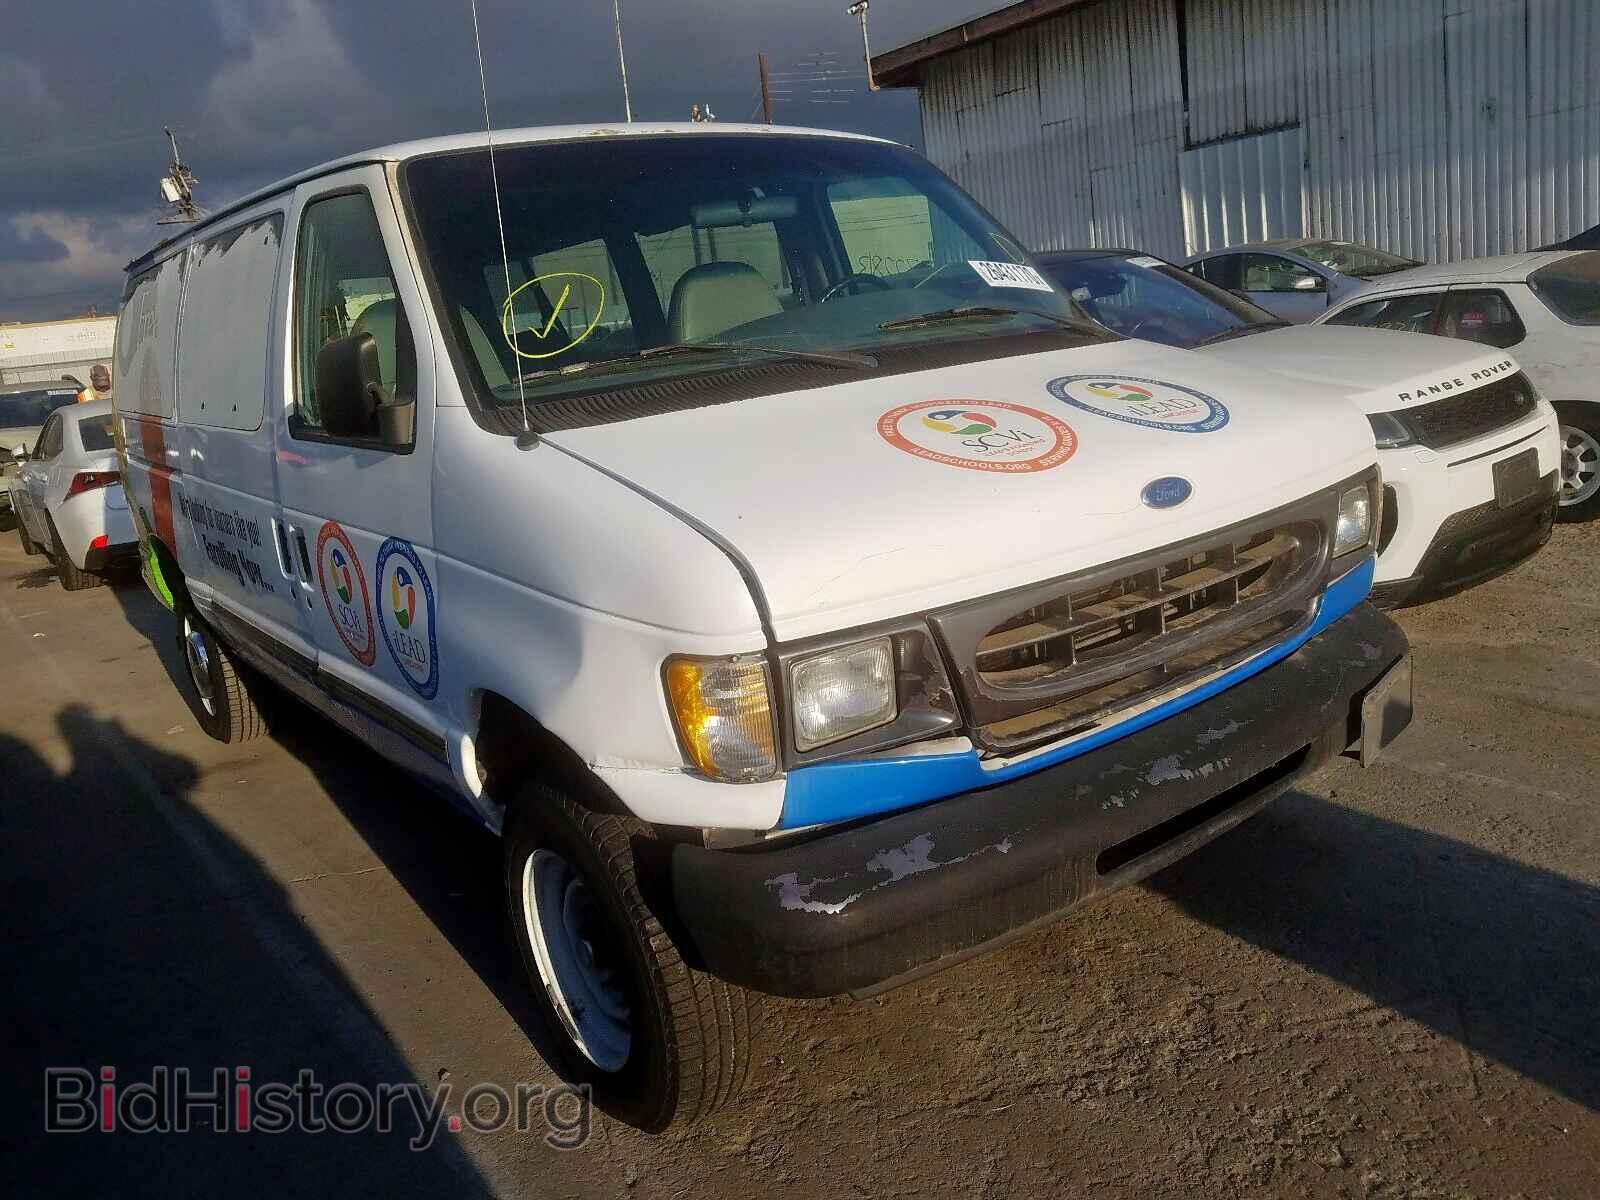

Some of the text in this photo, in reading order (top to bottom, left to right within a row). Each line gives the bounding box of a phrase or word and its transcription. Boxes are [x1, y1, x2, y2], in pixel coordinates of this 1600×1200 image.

[1398, 360, 1513, 402] RANGE ROVER
[962, 430, 1042, 453] SCVi
[1147, 479, 1184, 502] Ford
[393, 631, 426, 665] iLEAD
